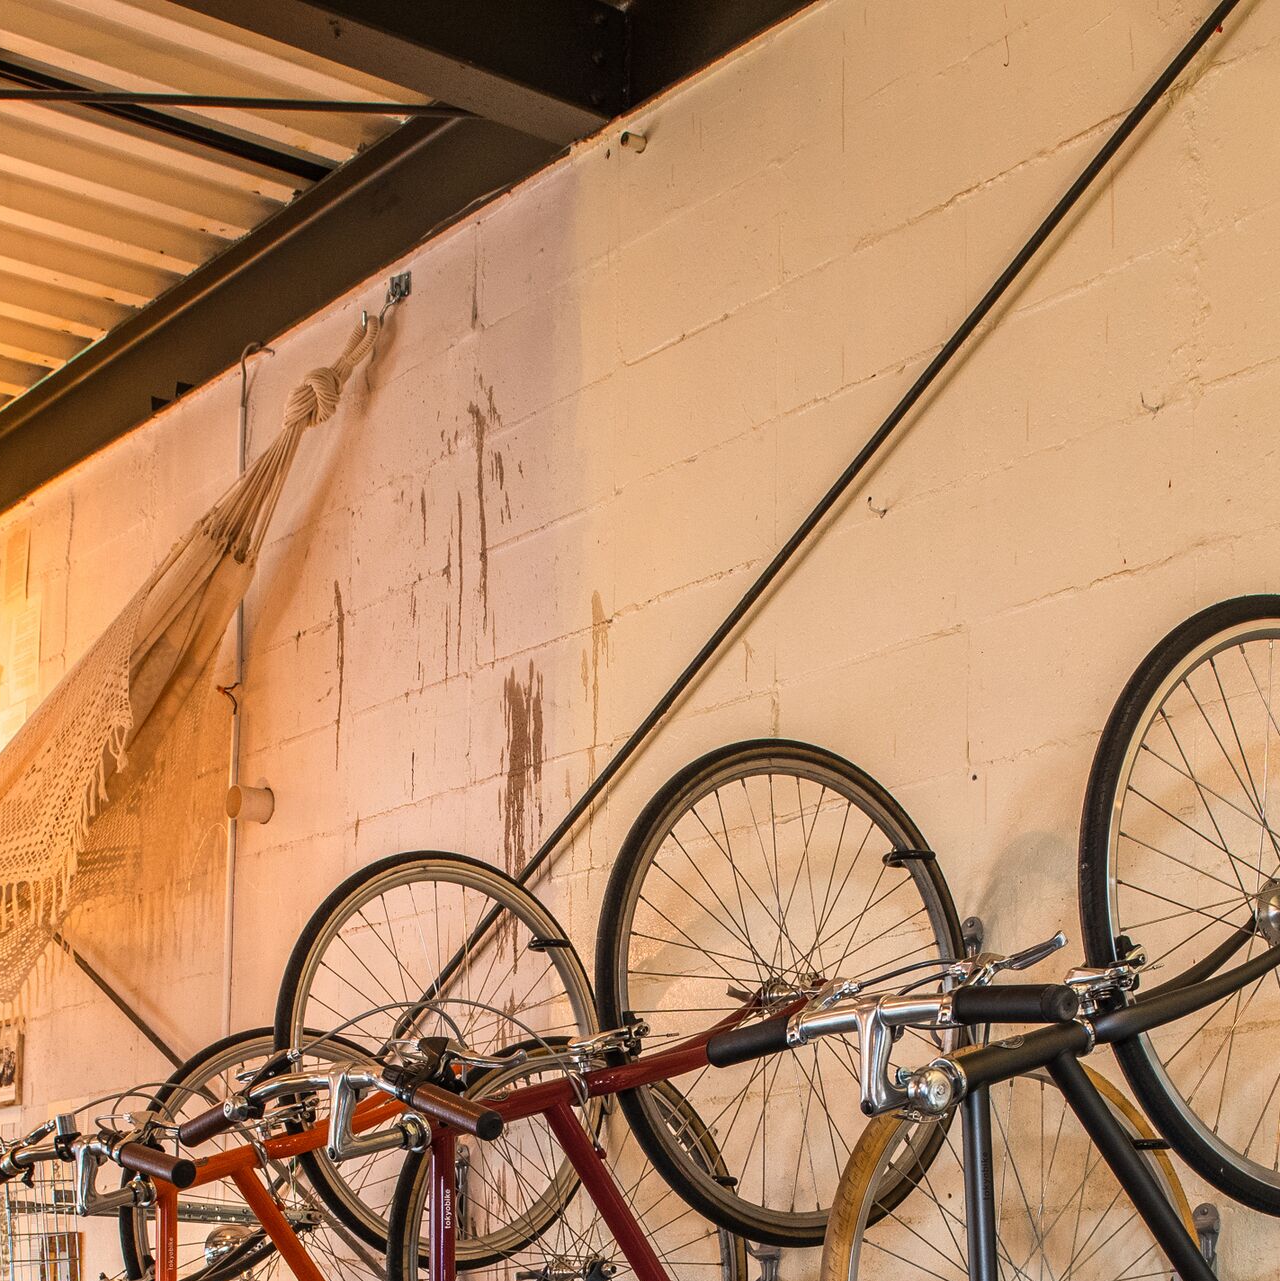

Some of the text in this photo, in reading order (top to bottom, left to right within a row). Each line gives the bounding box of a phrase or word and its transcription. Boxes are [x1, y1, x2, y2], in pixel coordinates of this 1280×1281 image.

[981, 1151, 991, 1201] tokyobike
[444, 1189, 452, 1230] tokyobike
[167, 1237, 175, 1271] tokyobike
